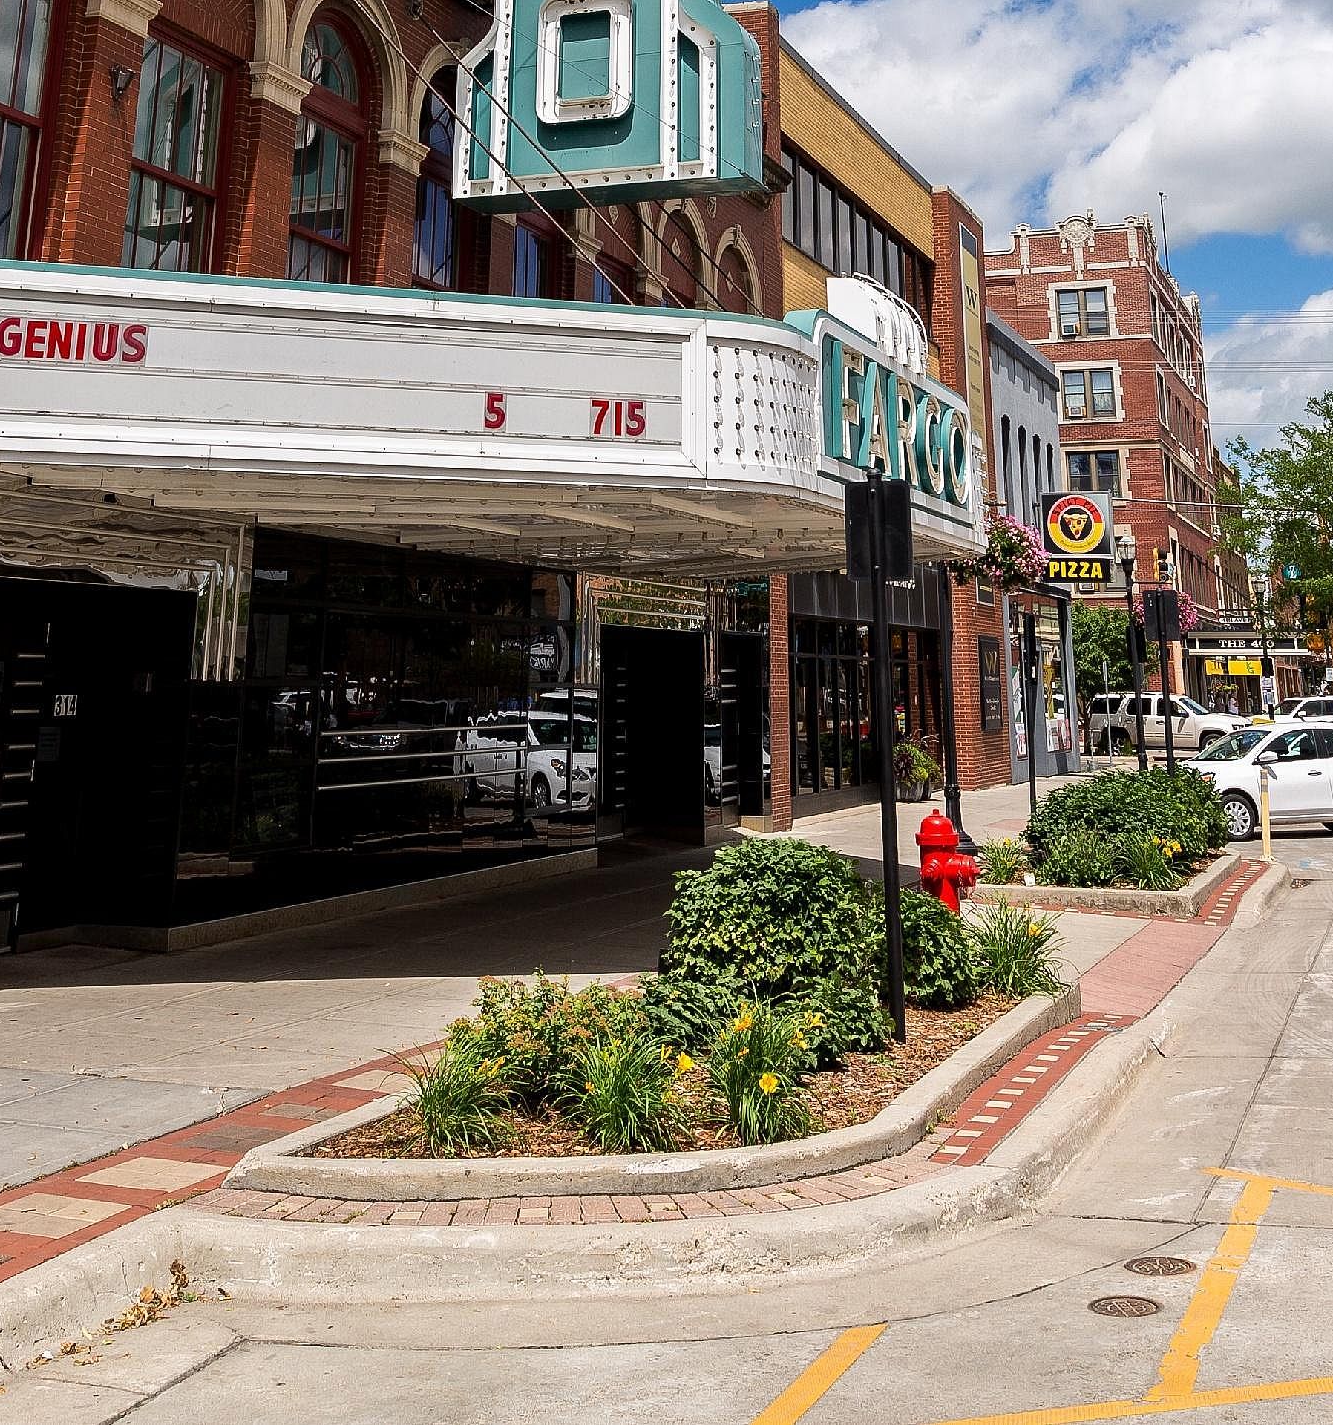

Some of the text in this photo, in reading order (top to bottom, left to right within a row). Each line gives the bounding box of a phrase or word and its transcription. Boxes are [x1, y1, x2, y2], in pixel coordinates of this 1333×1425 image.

[965, 285, 978, 309] W
[484, 393, 646, 437] 5 715
[831, 339, 970, 506] FARGO
[1049, 561, 1103, 579] PIZZA
[1218, 639, 1246, 648] THE
[55, 695, 77, 716] 314
